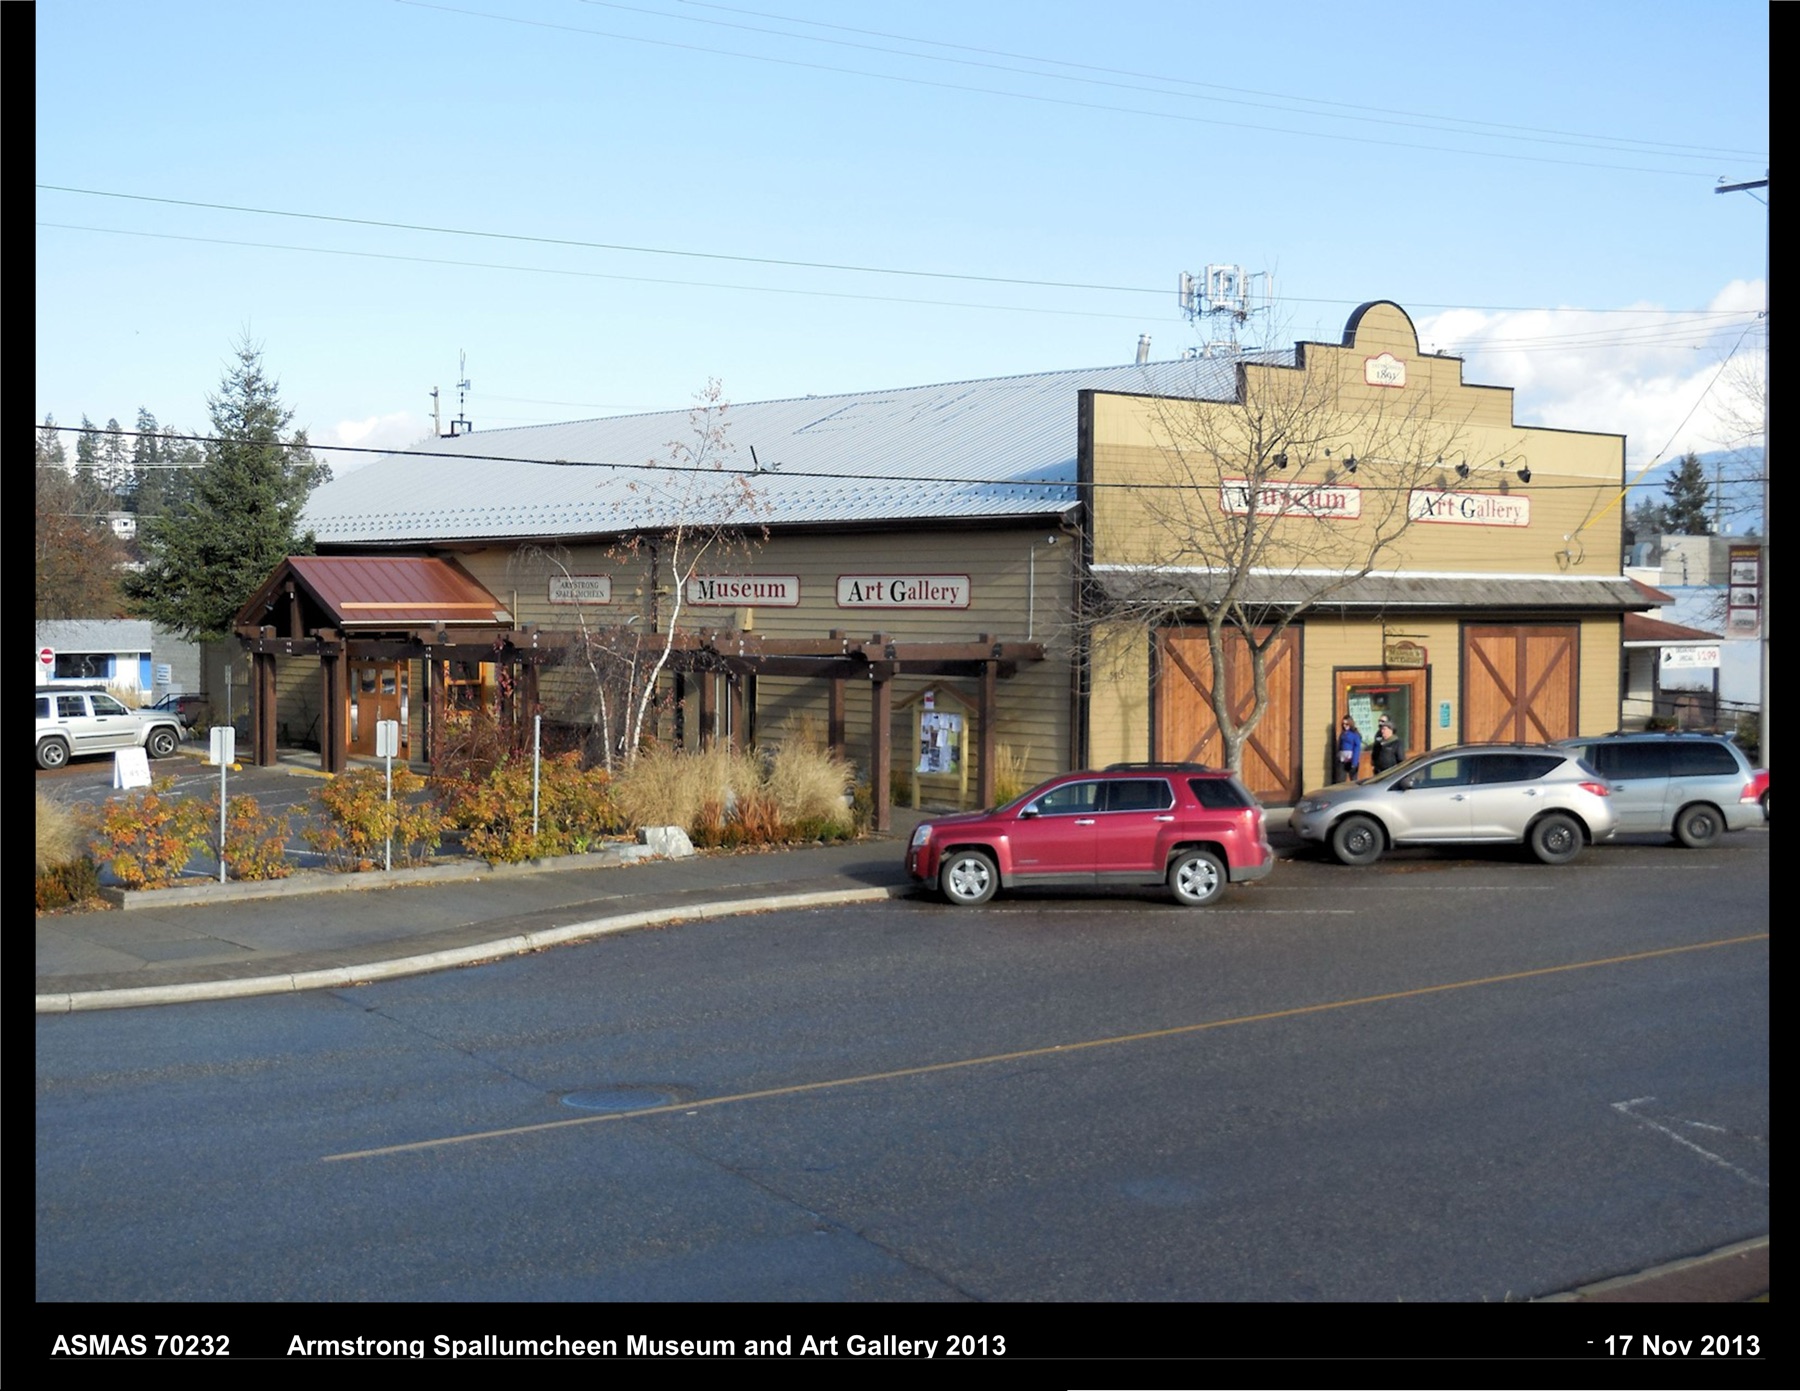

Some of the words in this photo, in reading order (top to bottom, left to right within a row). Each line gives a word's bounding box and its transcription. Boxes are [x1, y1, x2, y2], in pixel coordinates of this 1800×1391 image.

[1419, 496, 1454, 517] Art
[1461, 497, 1521, 524] Gallery
[698, 580, 786, 600] Museum
[848, 580, 883, 602] Art
[890, 580, 960, 604] Gallery
